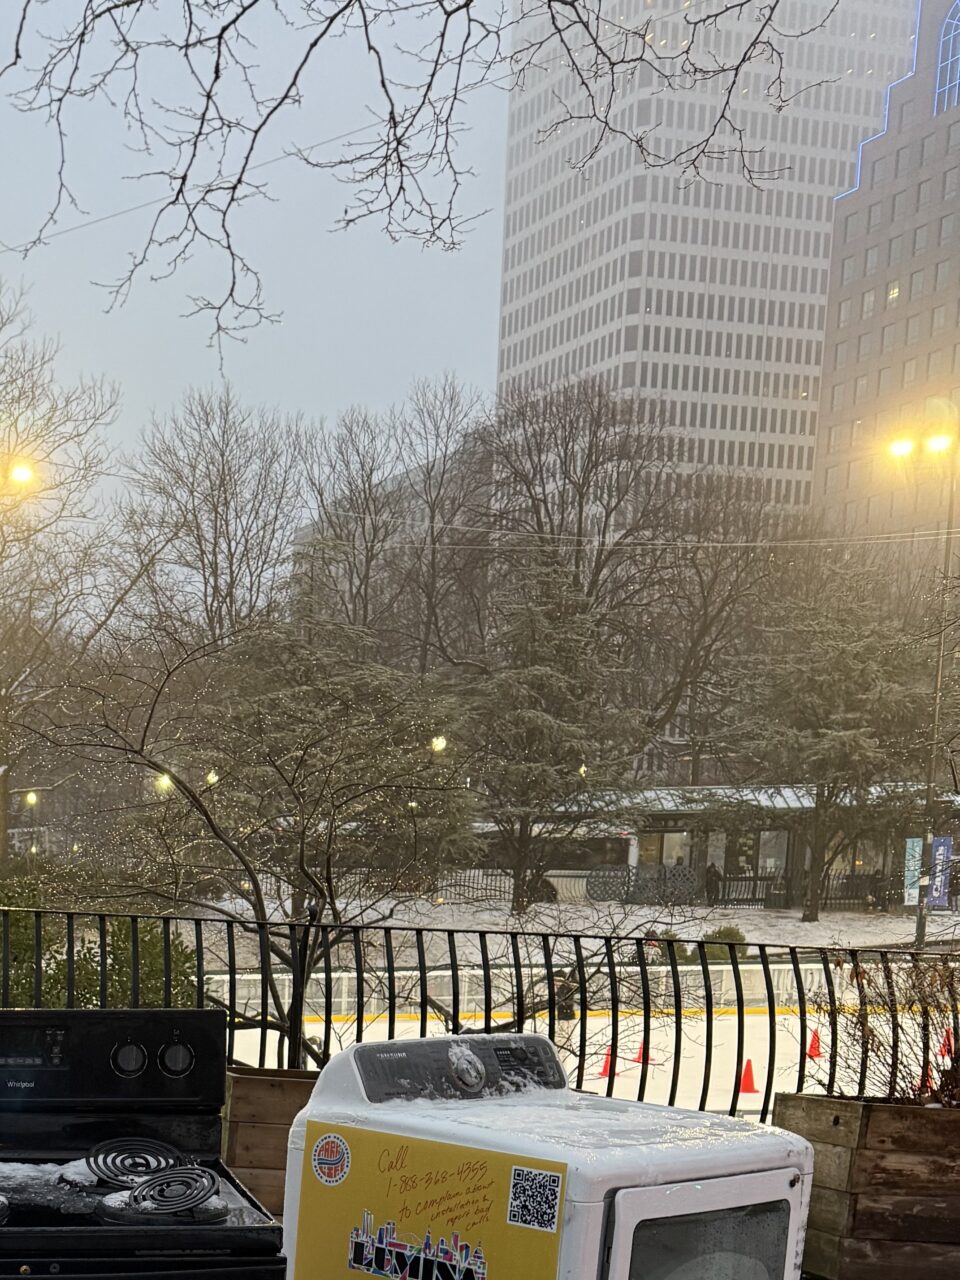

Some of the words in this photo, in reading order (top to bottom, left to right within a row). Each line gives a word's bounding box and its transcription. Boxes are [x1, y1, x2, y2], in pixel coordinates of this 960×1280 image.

[318, 1140, 343, 1158] PARK
[378, 1145, 409, 1173] Call
[386, 1161, 488, 1198] 1-888-368-4355
[399, 1201, 412, 1222] to
